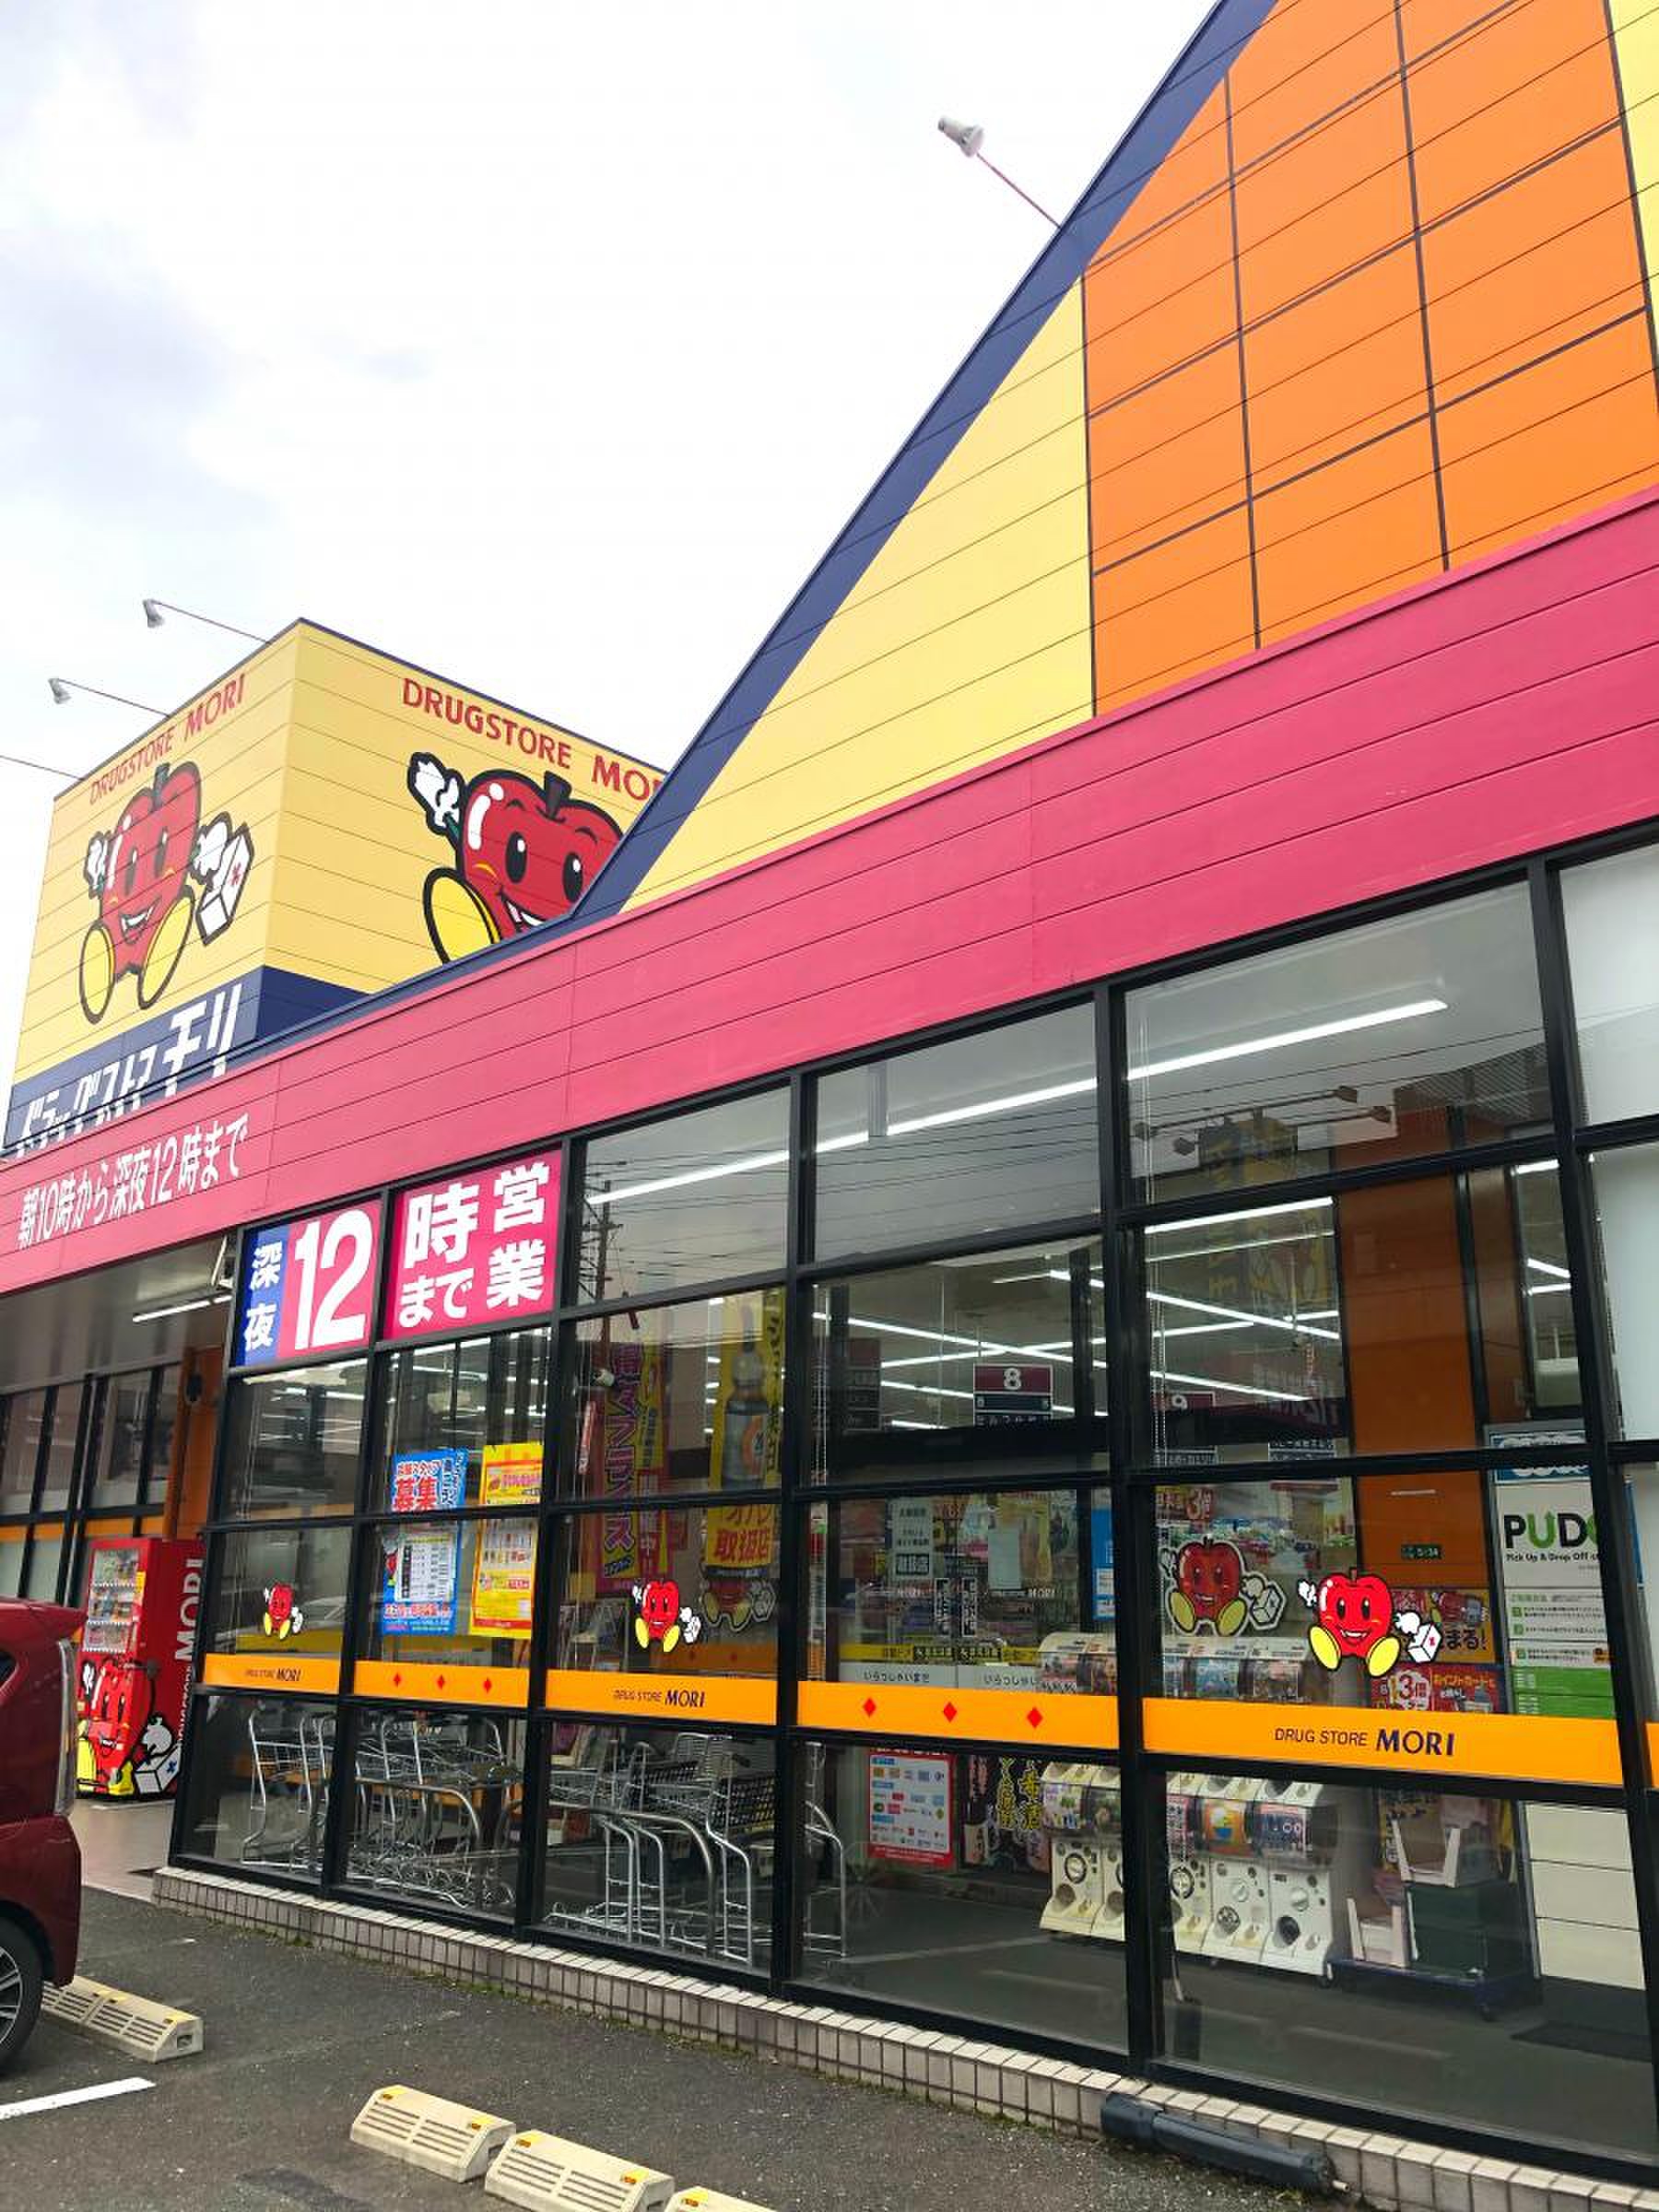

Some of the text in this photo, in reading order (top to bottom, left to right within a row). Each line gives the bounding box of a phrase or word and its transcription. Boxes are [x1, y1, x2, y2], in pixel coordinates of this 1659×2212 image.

[89, 673, 246, 805] DRUGSTORE MORI
[402, 678, 571, 770] DRUGSTORE
[293, 1208, 373, 1350] 12
[1003, 1367, 1022, 1391] 8
[665, 1689, 705, 1708] MORI
[1275, 1727, 1455, 1757] DRUG STORE MORI
